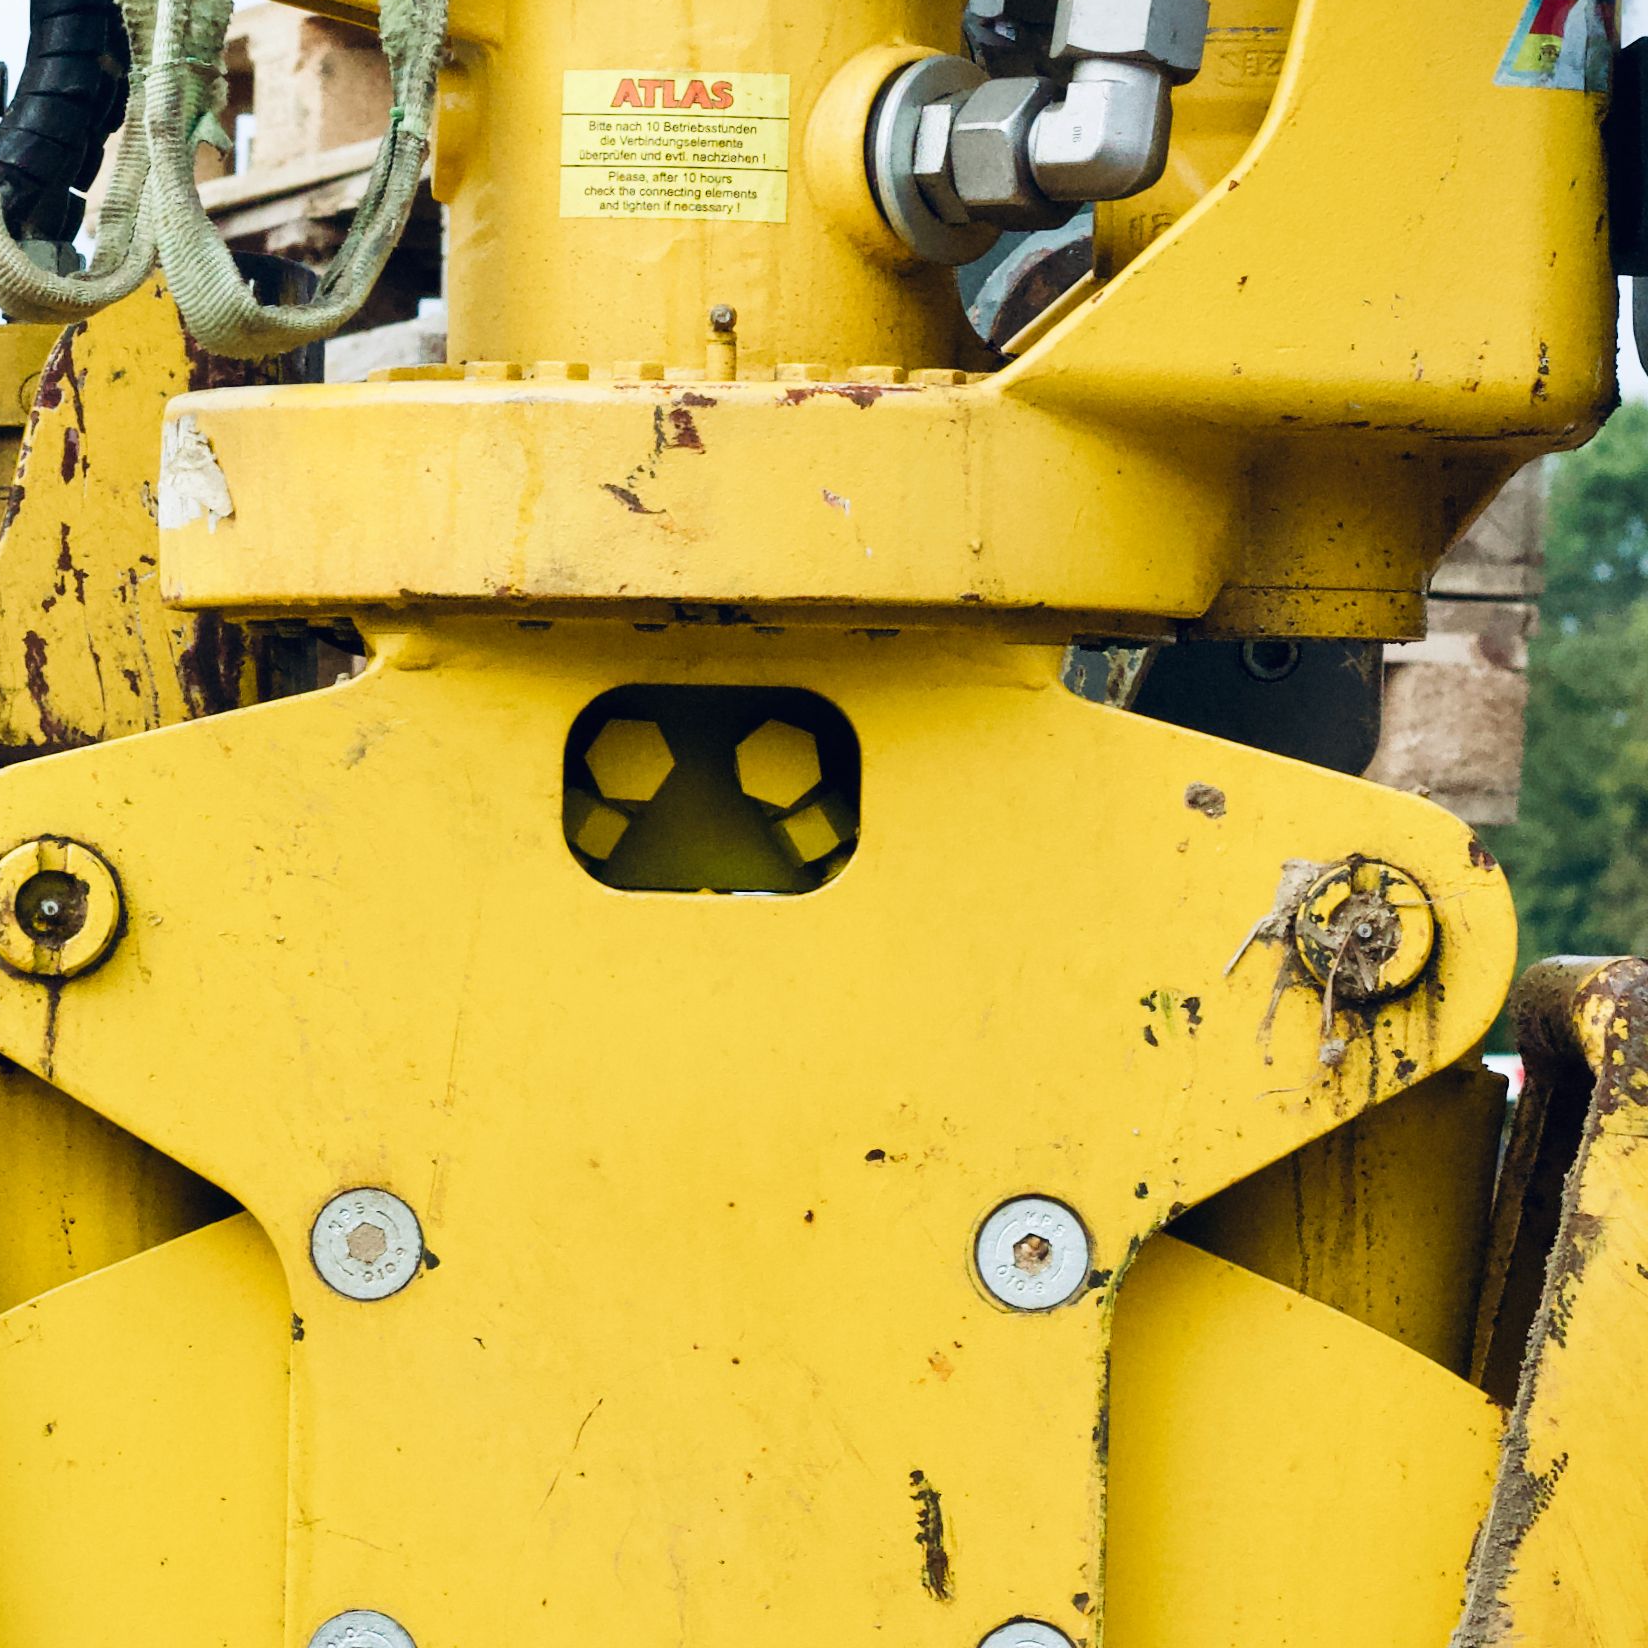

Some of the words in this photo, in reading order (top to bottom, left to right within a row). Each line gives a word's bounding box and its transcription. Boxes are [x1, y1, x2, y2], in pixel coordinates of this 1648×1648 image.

[610, 78, 734, 110] ATLAS
[588, 120, 613, 132] Bitte
[615, 121, 642, 132] nach
[647, 122, 660, 132] 10
[663, 121, 757, 134] Betriebsstunden
[599, 135, 616, 145] die
[619, 135, 744, 149] Verbindungselemente
[578, 149, 637, 162] überprüfen
[640, 151, 661, 161] und
[665, 152, 688, 161] evtl.
[692, 152, 759, 163] nachziehen
[608, 171, 649, 183] Please,
[652, 171, 678, 183] after
[683, 172, 697, 183] 10
[700, 172, 733, 183] hours
[584, 186, 615, 196] check
[618, 186, 636, 196] the
[639, 187, 701, 200] connecting
[705, 188, 758, 199] elements
[599, 200, 619, 210] and
[623, 201, 660, 213] tighten
[664, 200, 672, 211] if
[673, 202, 734, 214] necessary
